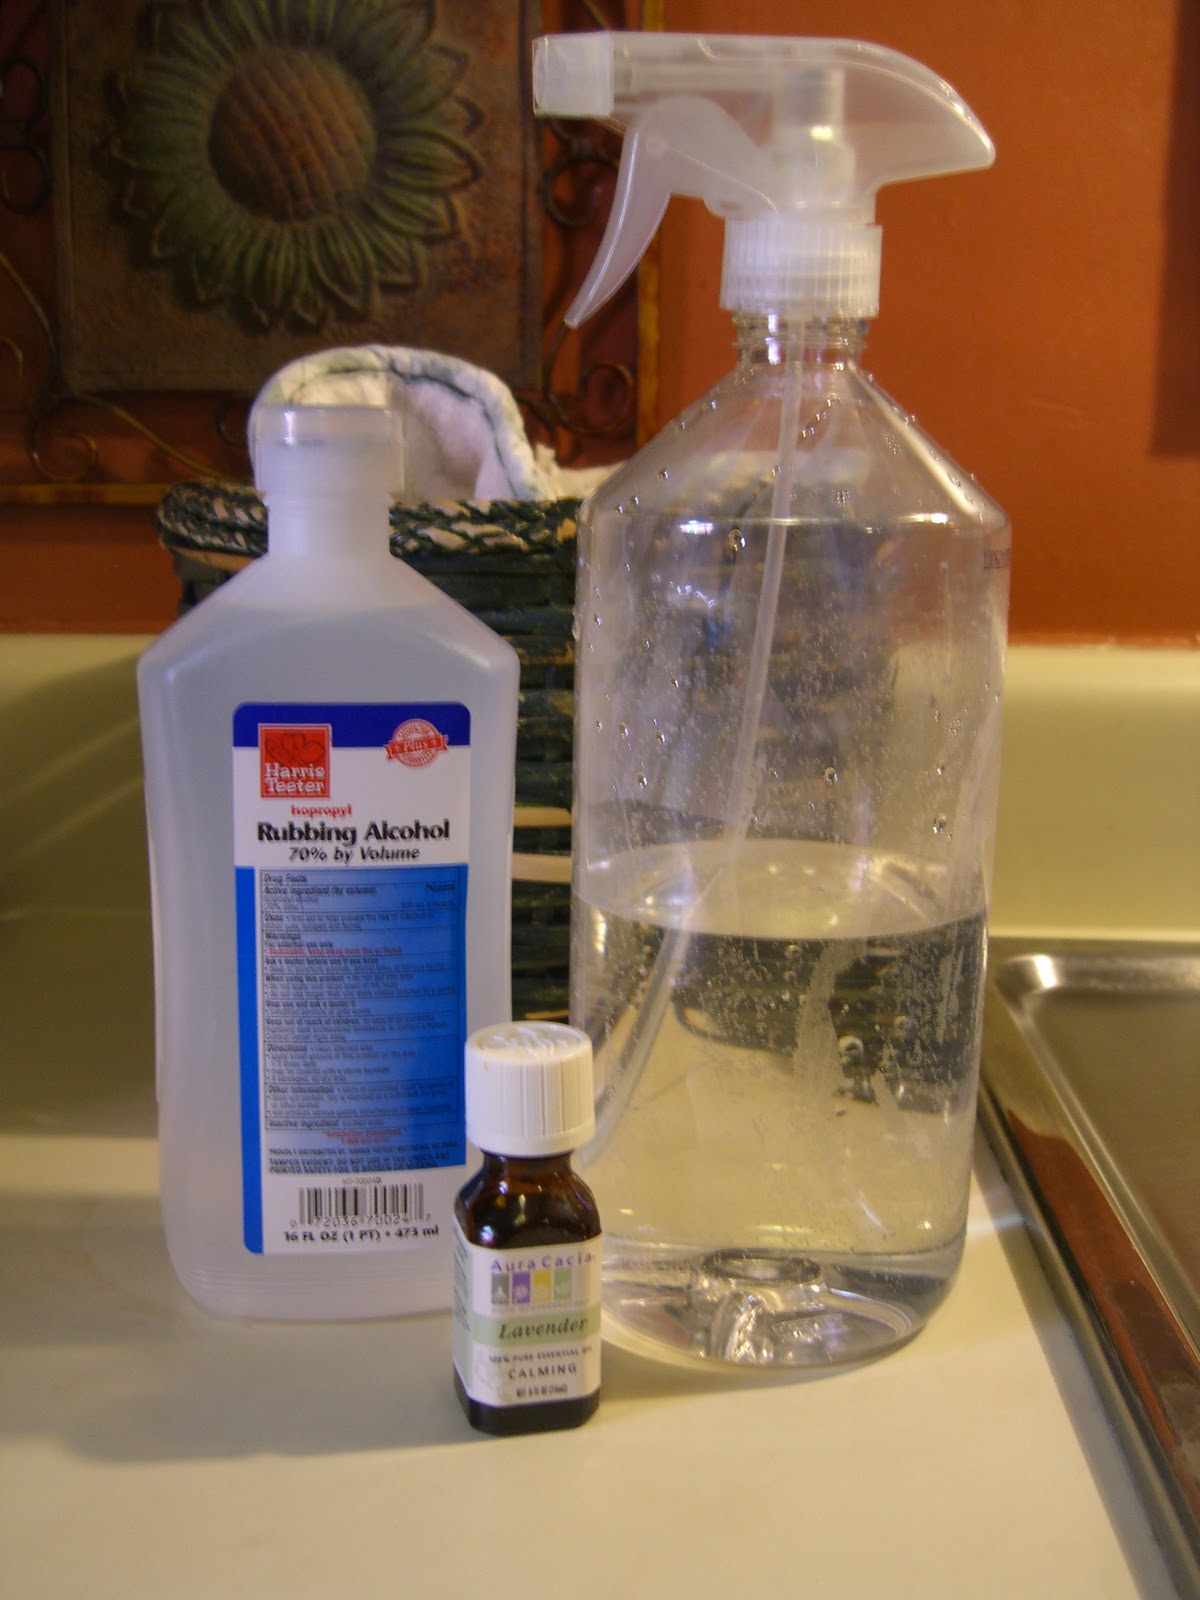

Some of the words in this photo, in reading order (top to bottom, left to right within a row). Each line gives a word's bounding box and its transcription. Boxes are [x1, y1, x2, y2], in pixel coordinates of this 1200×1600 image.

[264, 762, 325, 779] Harris
[265, 778, 325, 794] Teeter
[291, 803, 352, 818] Isopropyl
[257, 821, 357, 847] Rubbing
[363, 818, 450, 842] Alcohol
[289, 847, 328, 861] 70%
[334, 846, 354, 864] by
[360, 846, 420, 861] Volume
[284, 1230, 298, 1241] 16
[302, 1231, 315, 1241] FL
[320, 1230, 338, 1241] OZ
[359, 1228, 381, 1241] PT)
[395, 1227, 418, 1238] 473
[423, 1225, 439, 1236] ml
[499, 1317, 588, 1339] Lavender
[508, 1362, 577, 1380] CALMING
